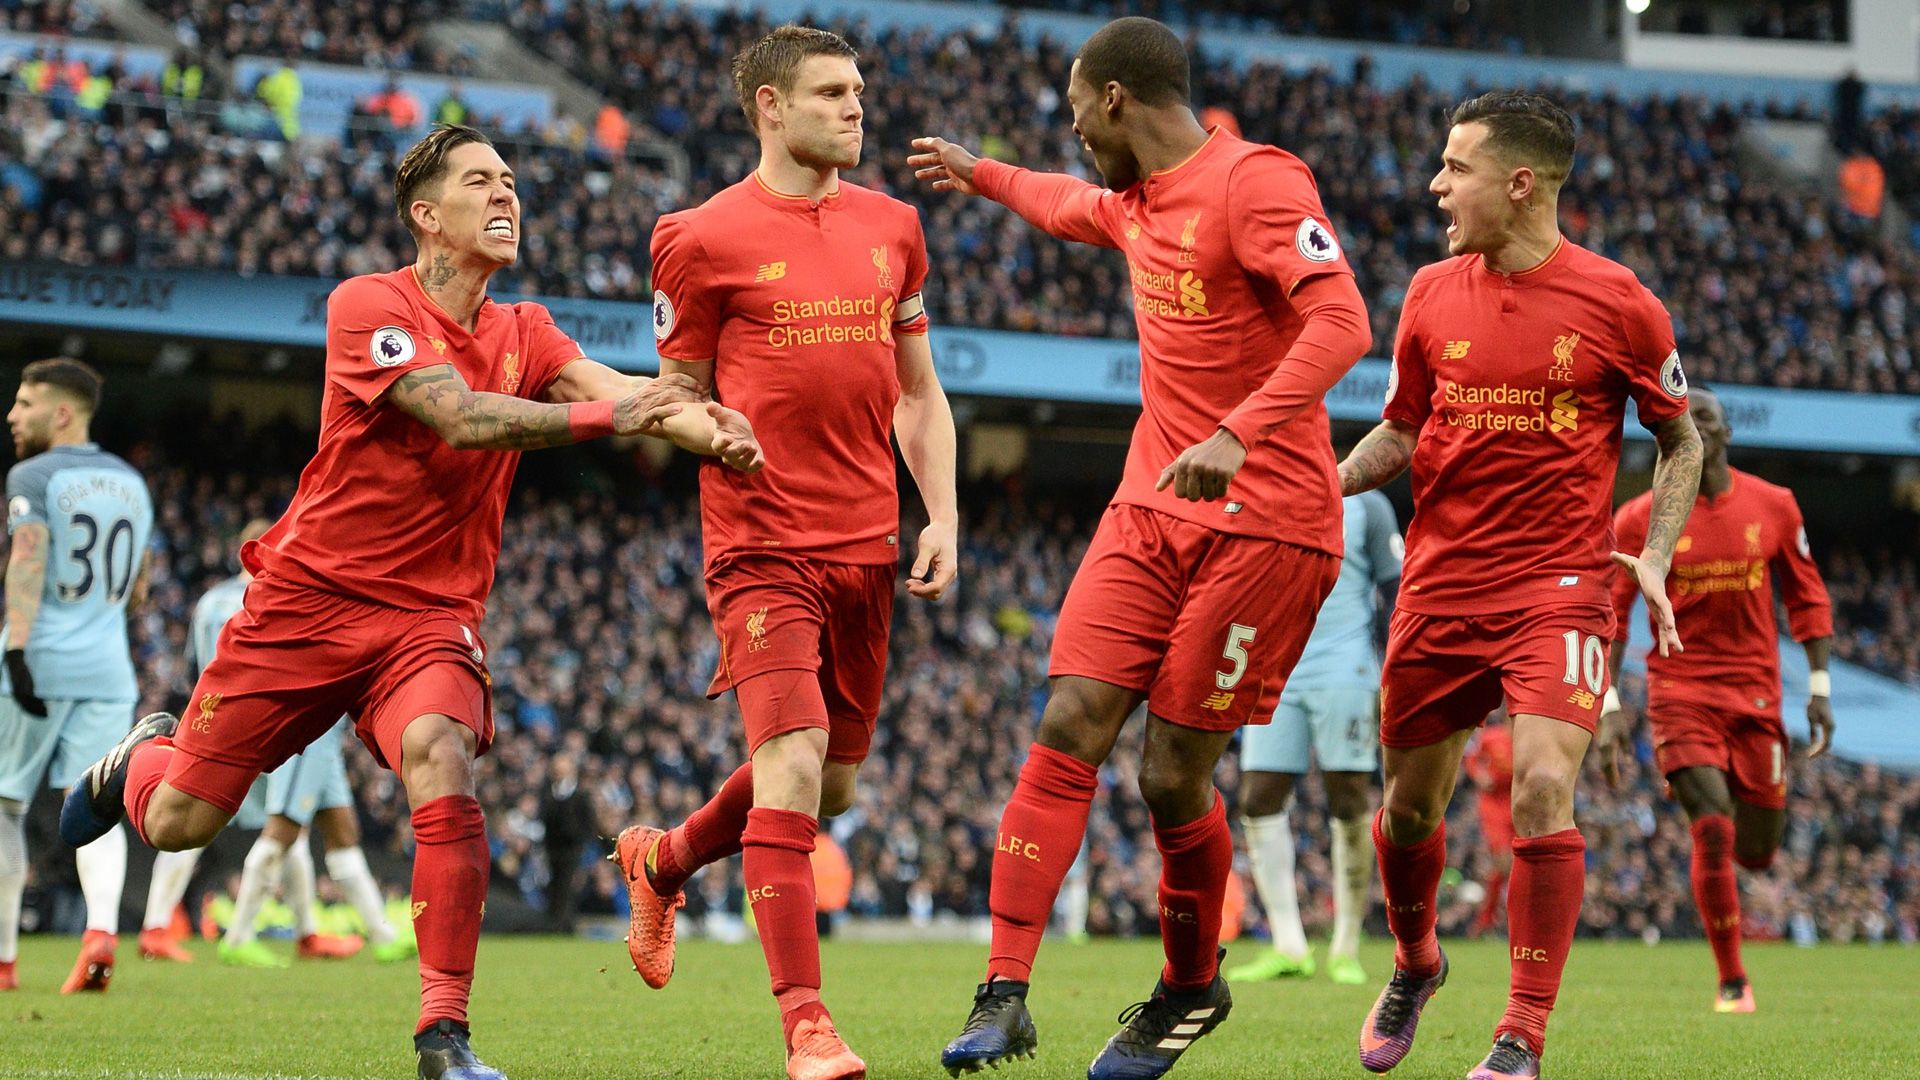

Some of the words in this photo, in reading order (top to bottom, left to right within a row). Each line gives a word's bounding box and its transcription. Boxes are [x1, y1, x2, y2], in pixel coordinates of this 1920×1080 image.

[64, 271, 177, 311] TODAY
[1130, 261, 1175, 292] Sandard
[773, 294, 876, 322] Standard
[768, 321, 877, 348] Chartered
[1445, 382, 1545, 407] Standard
[1446, 408, 1545, 432] Chartered
[57, 476, 143, 518] OTAMEND
[57, 512, 135, 605] 30
[1216, 623, 1257, 690] 5
[1562, 630, 1605, 695] 10
